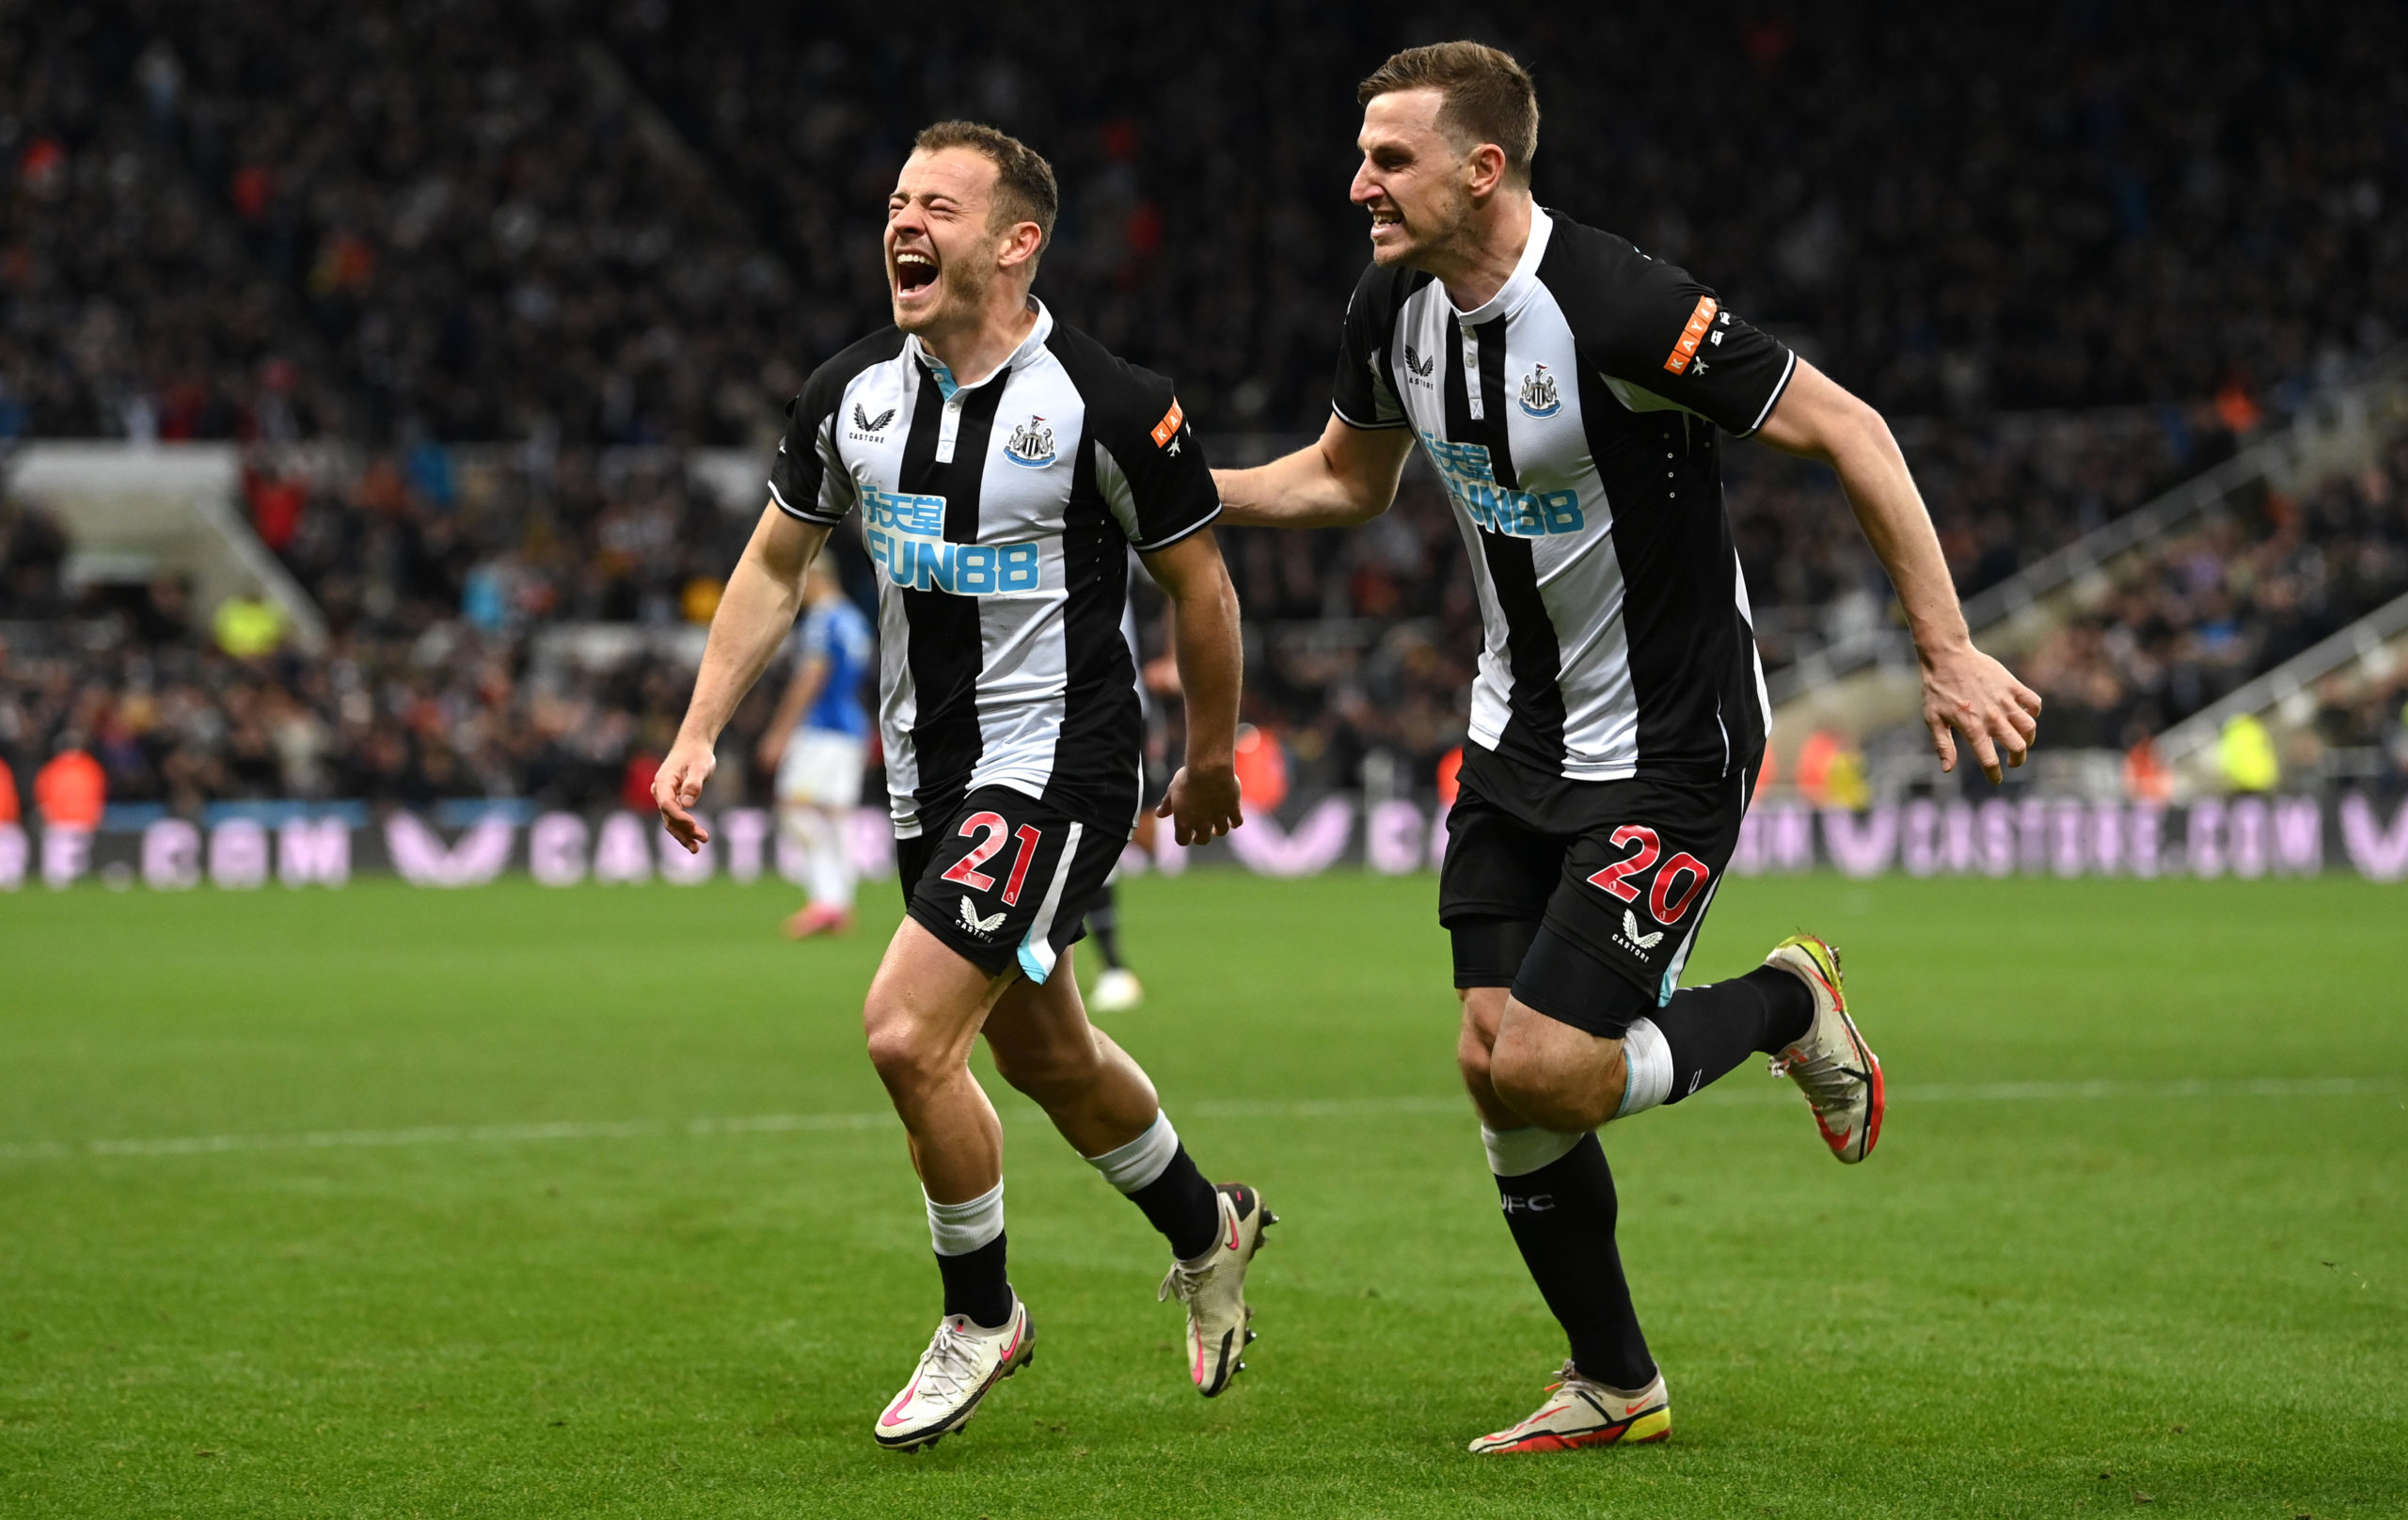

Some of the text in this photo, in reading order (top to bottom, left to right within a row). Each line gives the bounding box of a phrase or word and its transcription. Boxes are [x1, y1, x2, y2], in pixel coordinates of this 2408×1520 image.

[848, 432, 885, 444] CASTORE
[866, 529, 1039, 594] FUN88
[941, 811, 1041, 908] 21
[1586, 824, 1710, 926] 20
[1611, 933, 1650, 963] CASTORE
